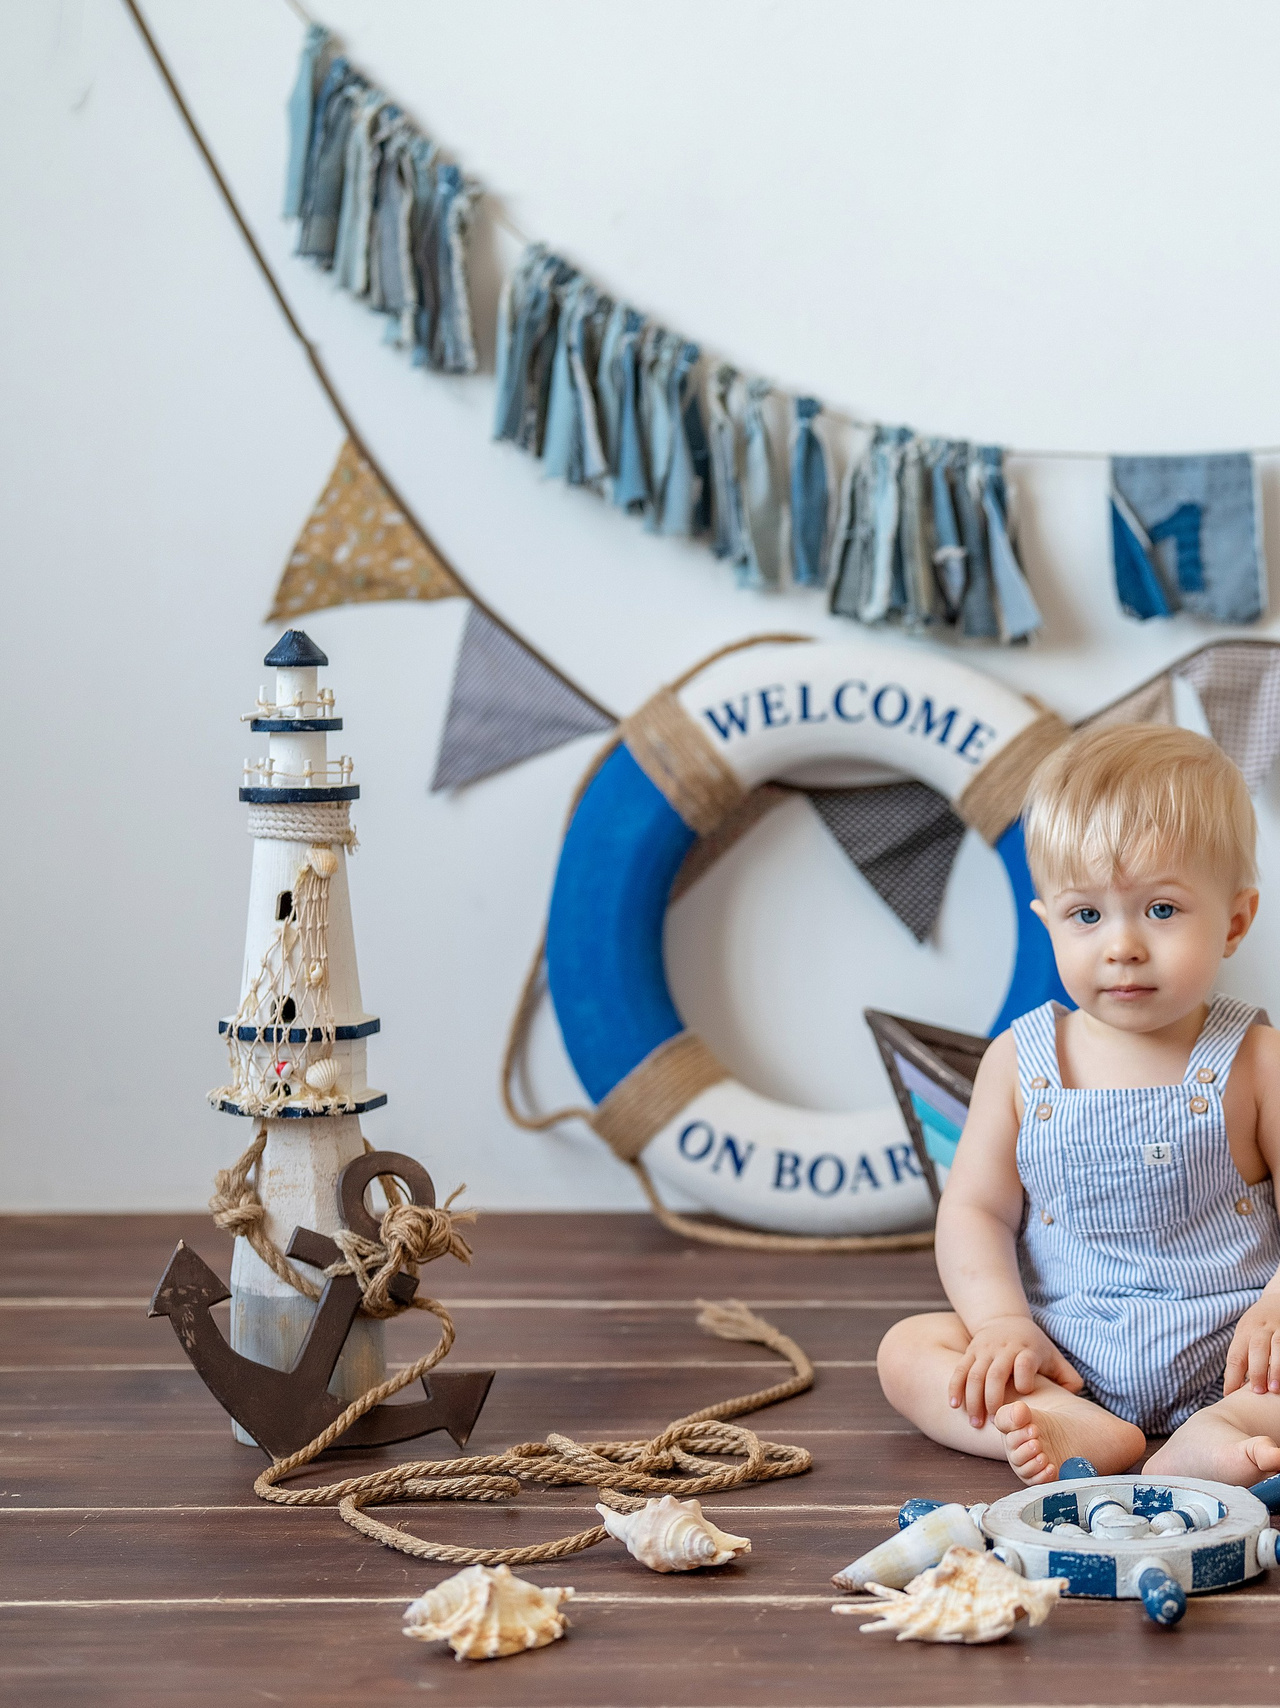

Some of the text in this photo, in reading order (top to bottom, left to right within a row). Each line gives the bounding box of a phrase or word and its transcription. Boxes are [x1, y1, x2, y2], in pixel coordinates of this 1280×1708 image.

[1149, 502, 1204, 592] 1
[704, 679, 998, 765] WELCOME
[678, 1119, 923, 1198] ON BOAR
